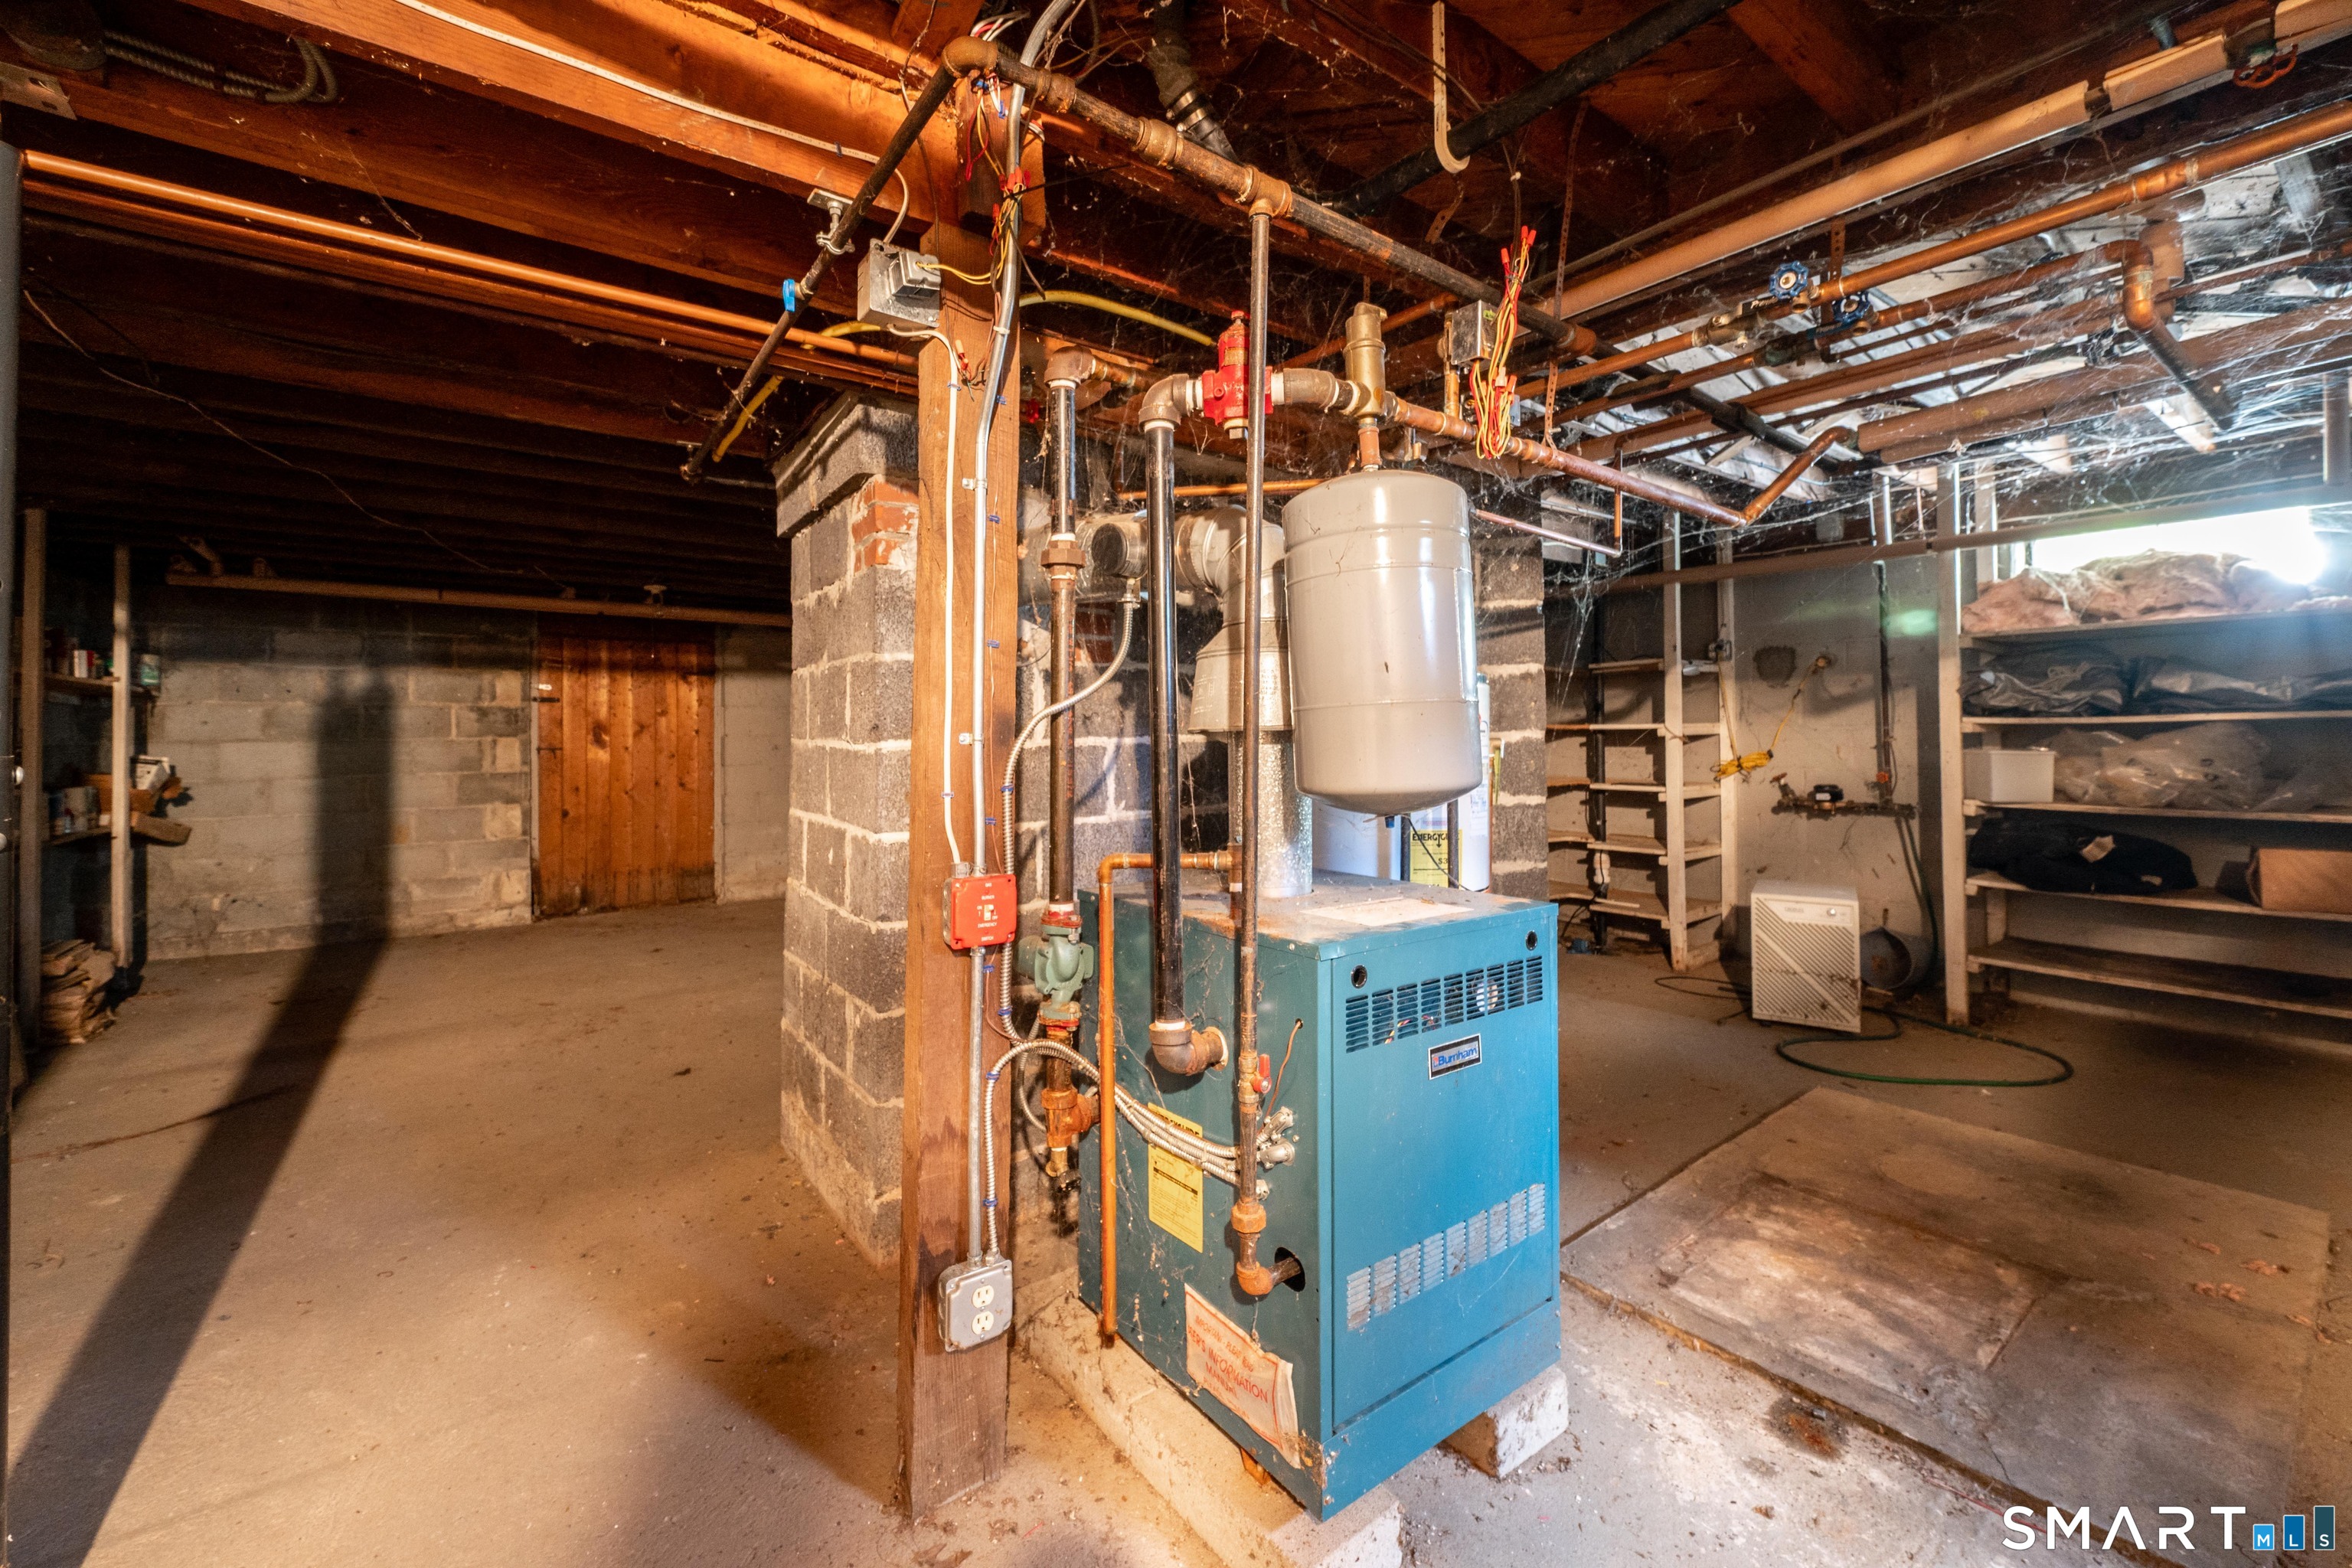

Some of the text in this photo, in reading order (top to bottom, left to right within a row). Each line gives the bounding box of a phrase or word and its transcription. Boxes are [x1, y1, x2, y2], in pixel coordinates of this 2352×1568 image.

[1438, 1047, 1478, 1067] Burnham
[1187, 1324, 1269, 1404] SER'S INFORMATION
[1205, 1361, 1240, 1400] MANUAL
